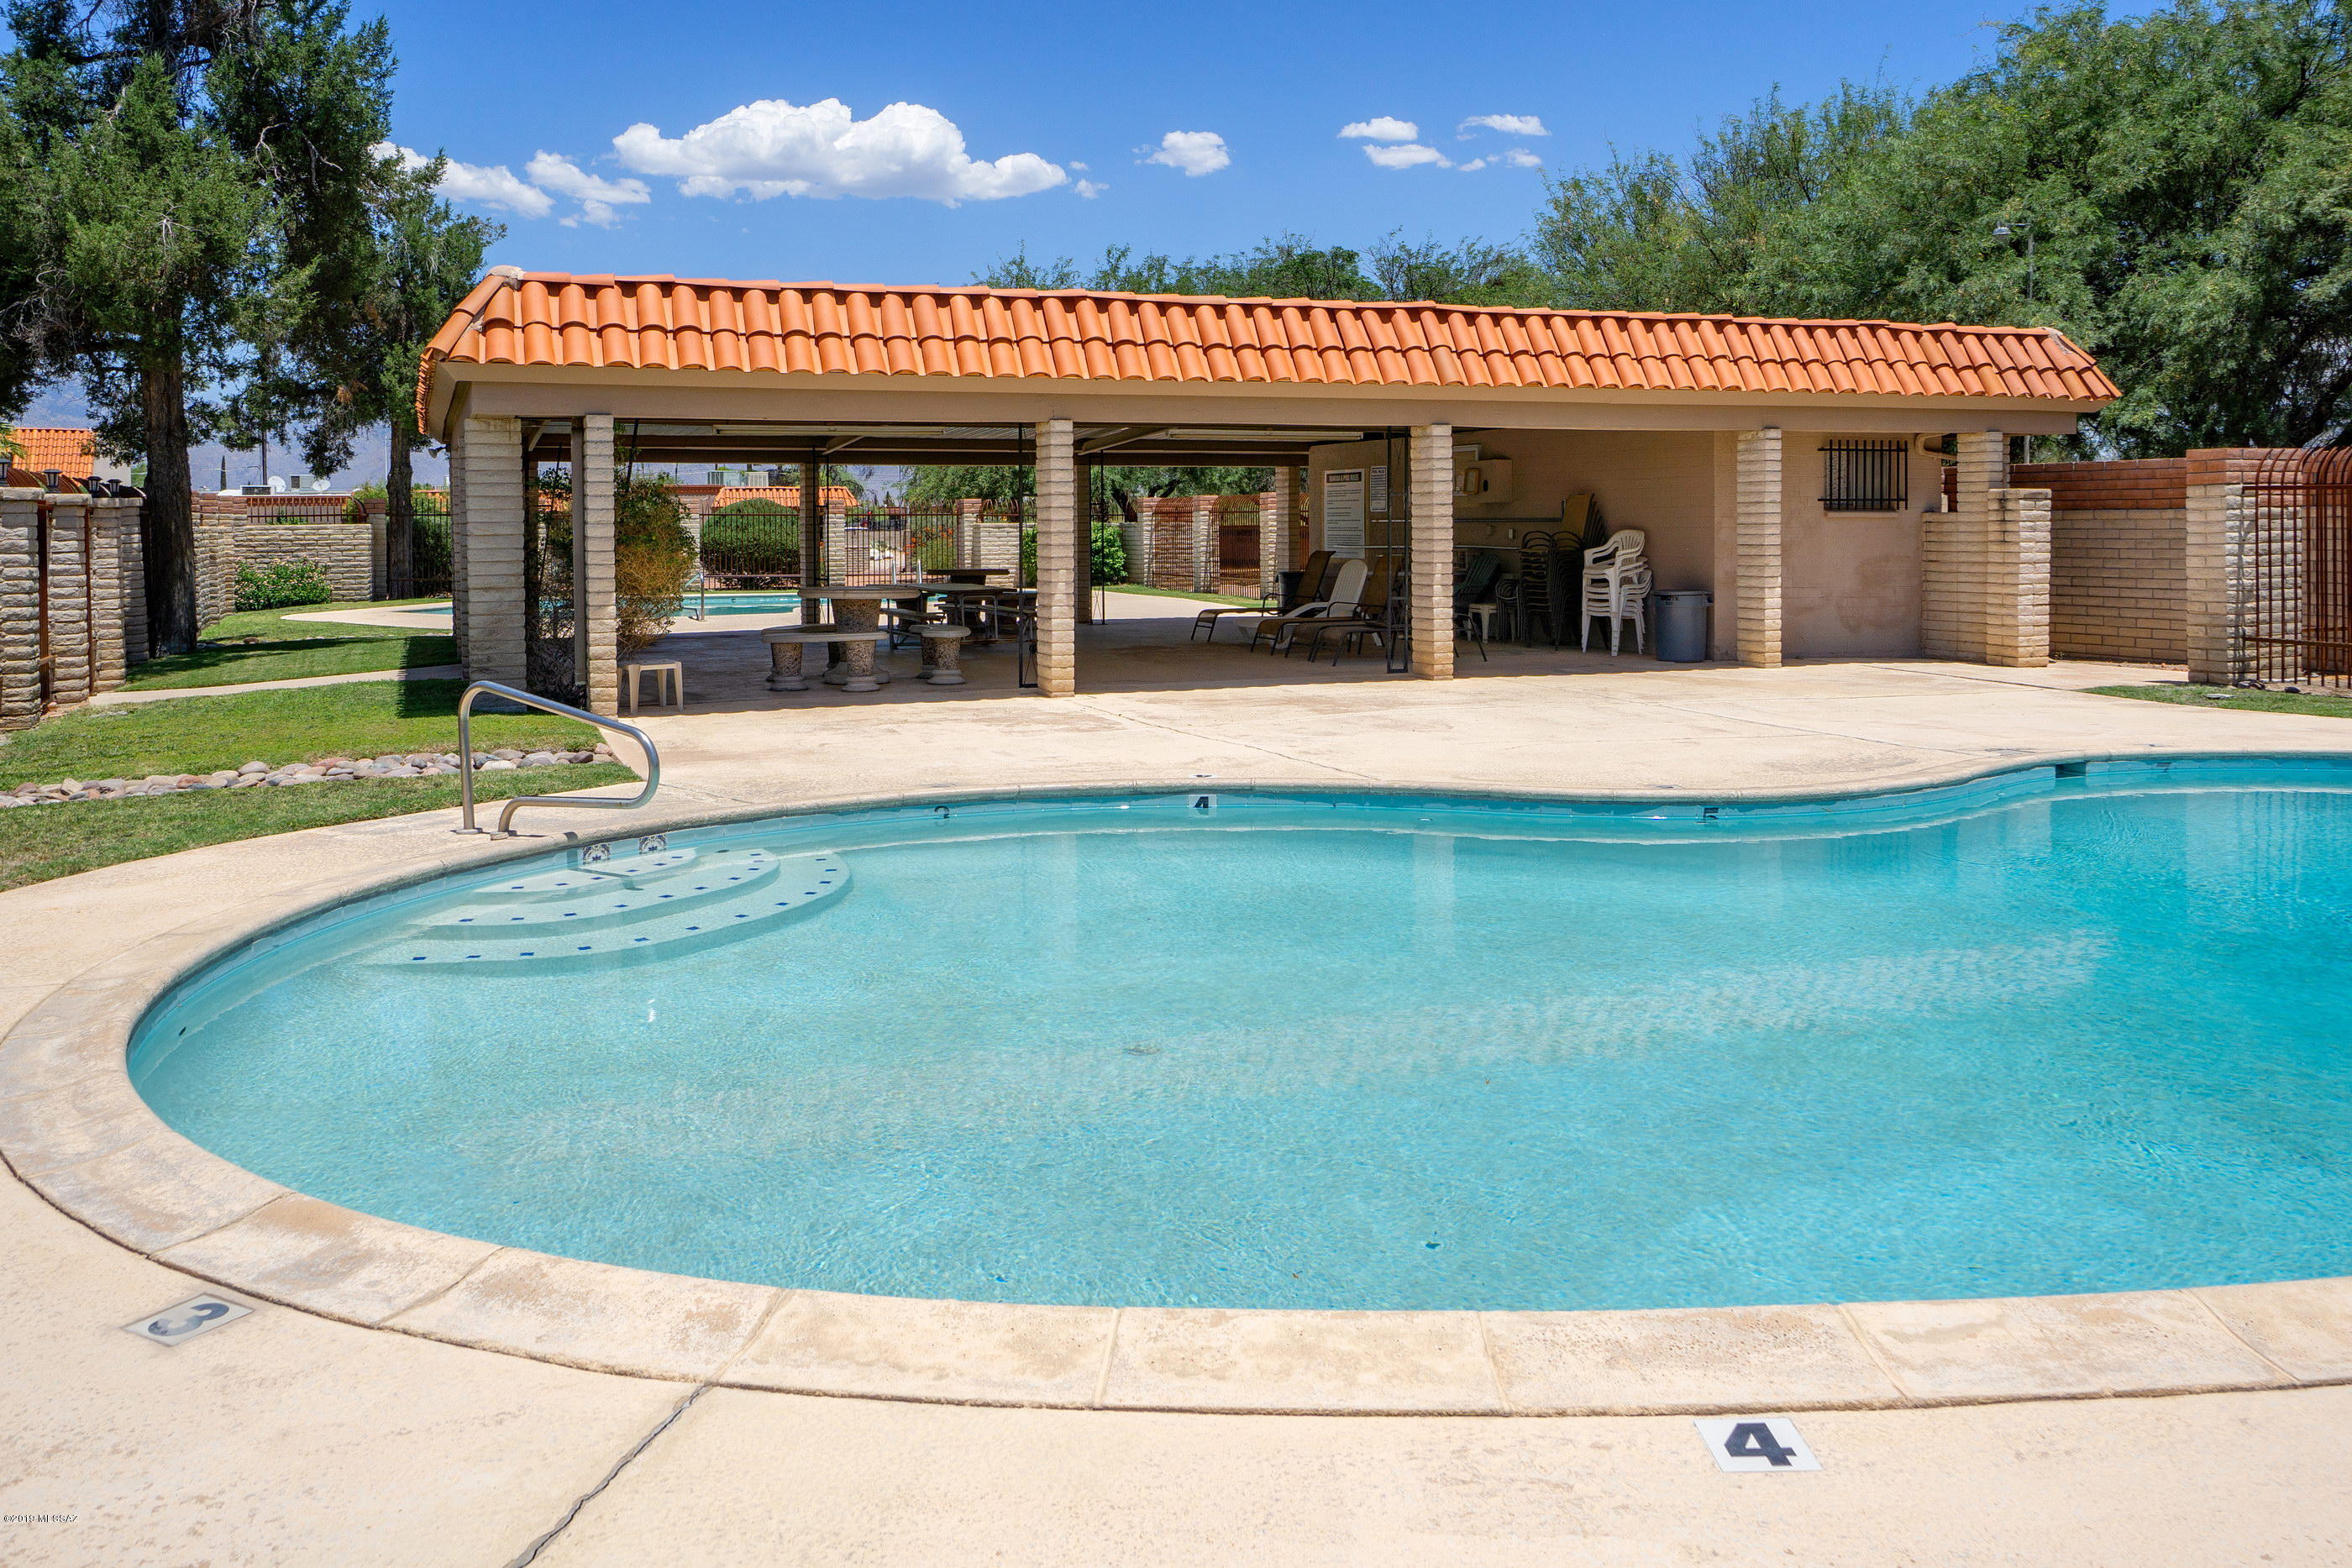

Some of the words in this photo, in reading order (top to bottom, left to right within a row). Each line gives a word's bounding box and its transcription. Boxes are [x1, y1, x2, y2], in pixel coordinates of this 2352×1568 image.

[1194, 796, 1210, 809] 4
[147, 1303, 229, 1336] 3
[1724, 1423, 1797, 1466] 4
